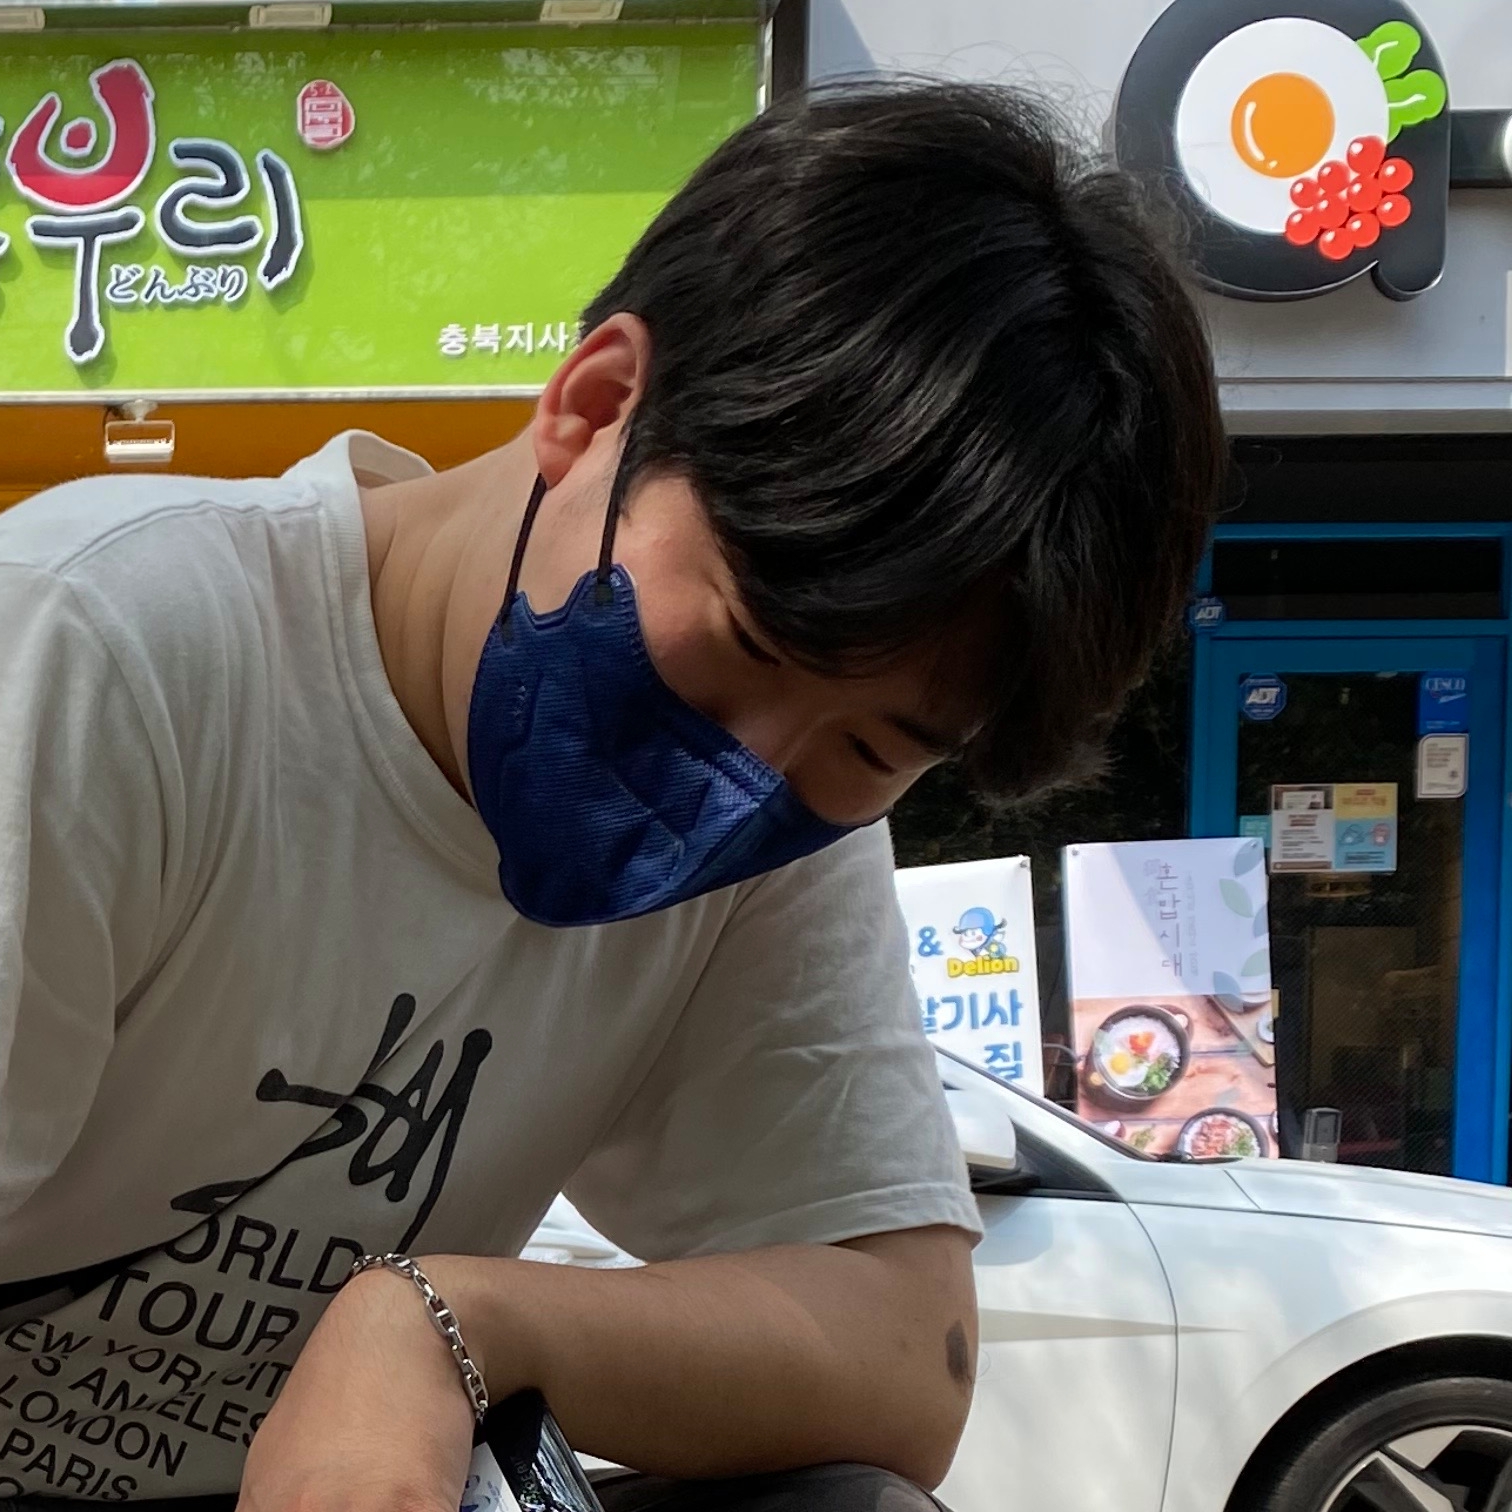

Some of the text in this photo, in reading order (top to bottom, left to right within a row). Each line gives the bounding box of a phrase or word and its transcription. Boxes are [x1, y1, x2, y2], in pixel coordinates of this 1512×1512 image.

[106, 260, 250, 304] どんぶり
[437, 322, 584, 357] 충북지사
[1194, 605, 1223, 620] ADT
[1245, 687, 1281, 705] ADT
[946, 954, 1021, 979] Delion
[163, 1214, 366, 1296] ORLD
[96, 1267, 301, 1356] TOUR
[3, 1319, 93, 1360] EW
